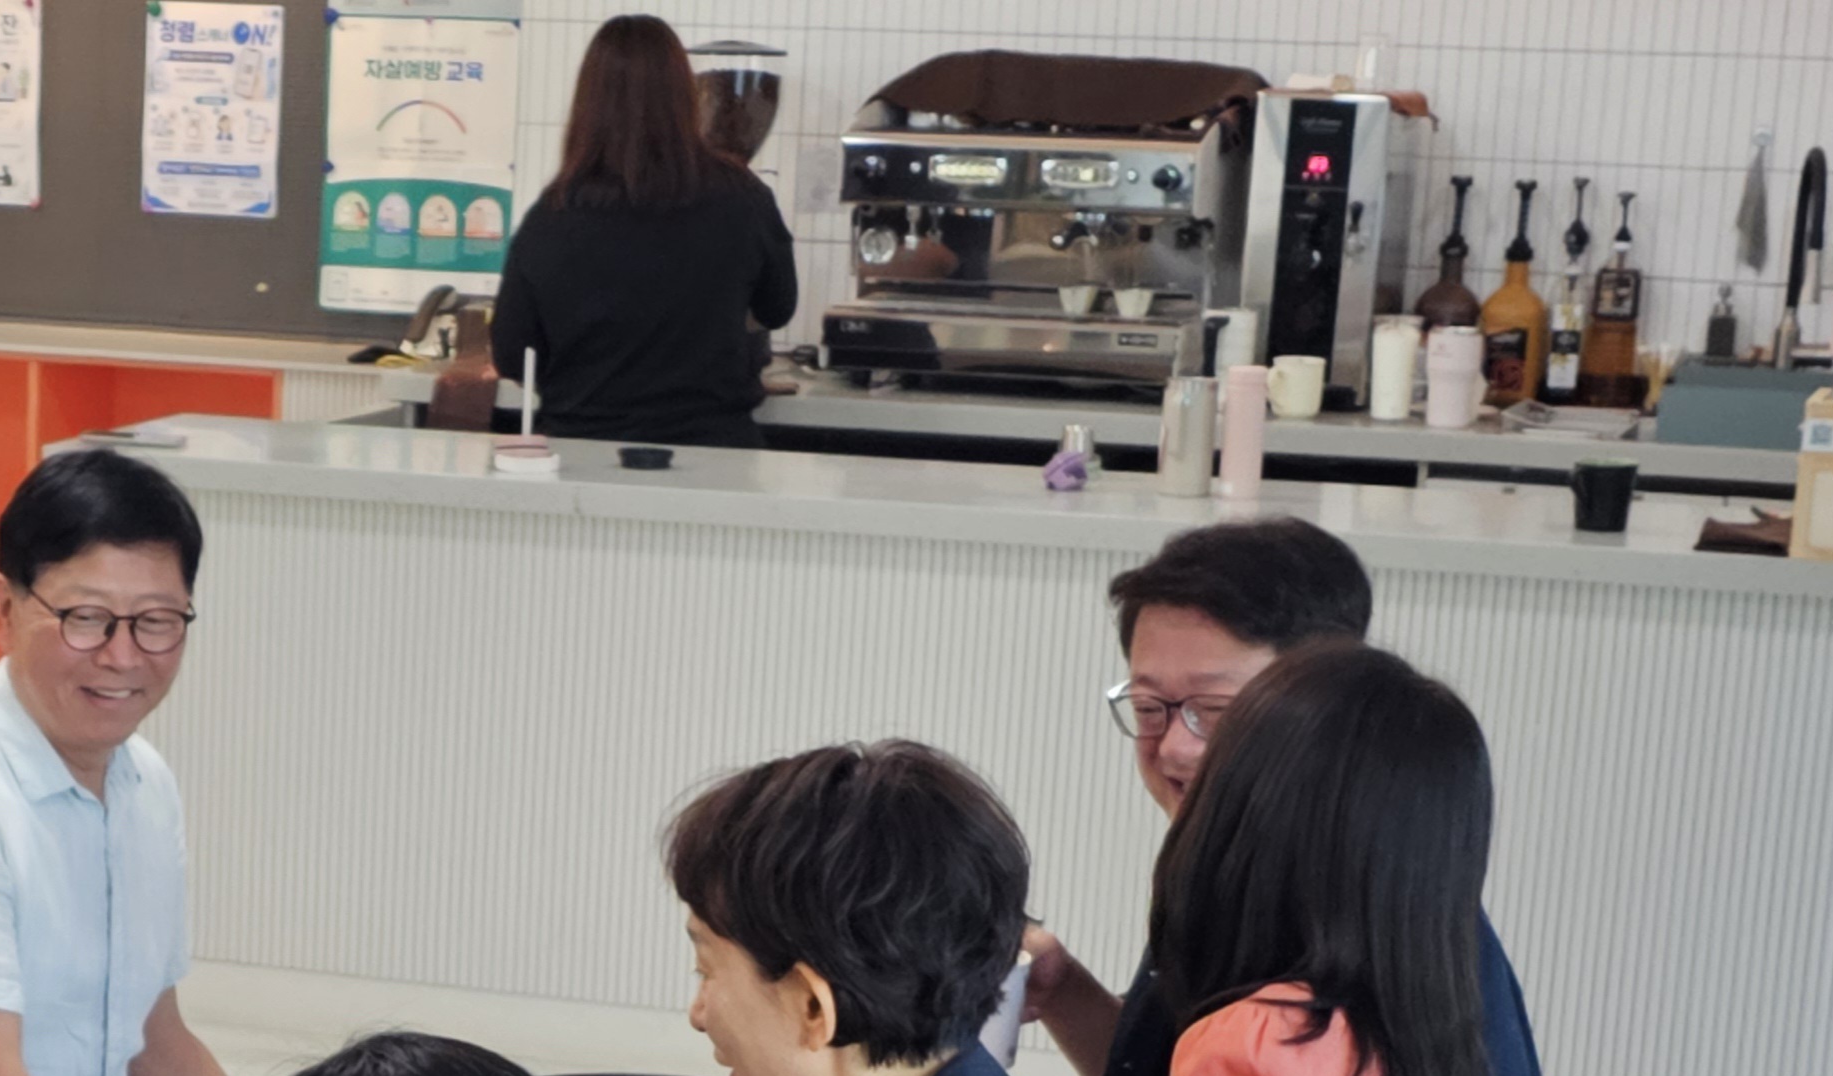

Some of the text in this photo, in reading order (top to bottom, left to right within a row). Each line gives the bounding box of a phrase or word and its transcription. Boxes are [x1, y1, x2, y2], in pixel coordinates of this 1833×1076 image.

[0, 13, 18, 36] 잔
[364, 59, 484, 82] 자살예방 교육
